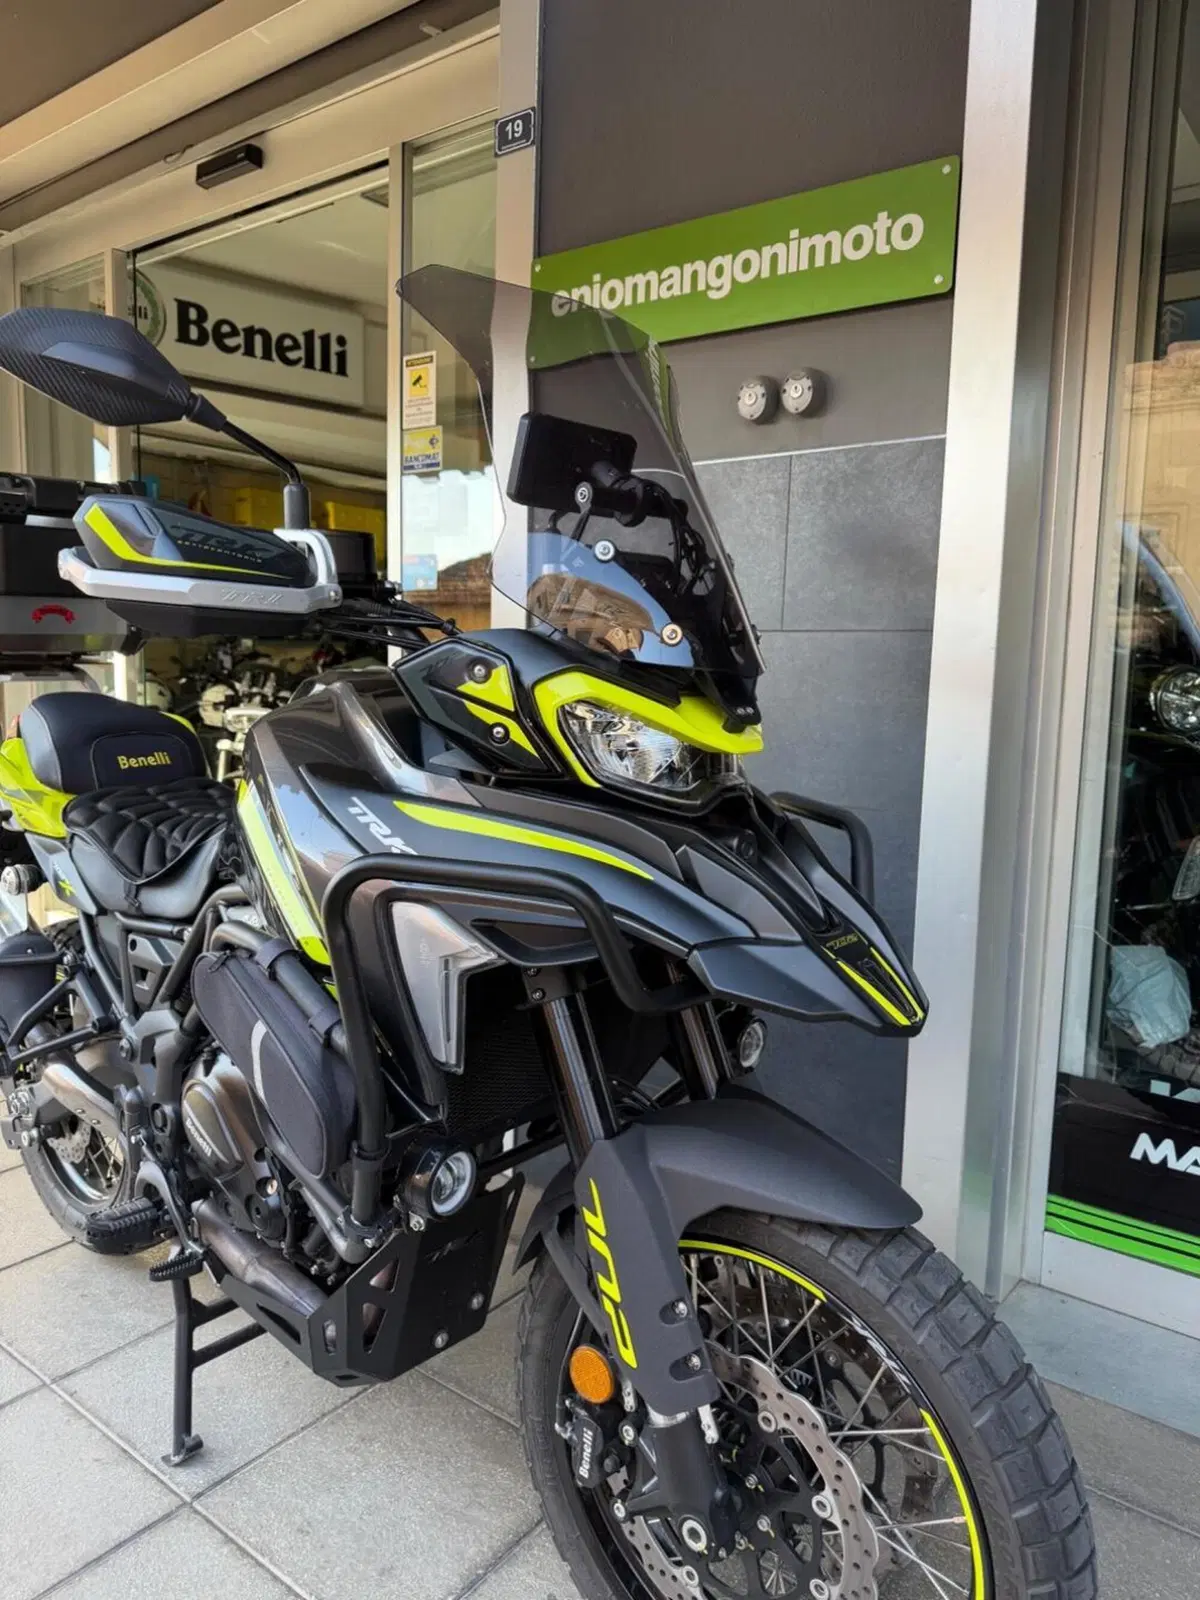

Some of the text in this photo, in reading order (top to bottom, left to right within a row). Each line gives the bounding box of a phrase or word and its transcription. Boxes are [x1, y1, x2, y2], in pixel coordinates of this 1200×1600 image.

[505, 119, 523, 140] 19
[551, 211, 924, 317] eniomangonimoto
[173, 297, 349, 377] Benelli
[117, 751, 172, 770] Benelli
[579, 1427, 593, 1479] Benelli
